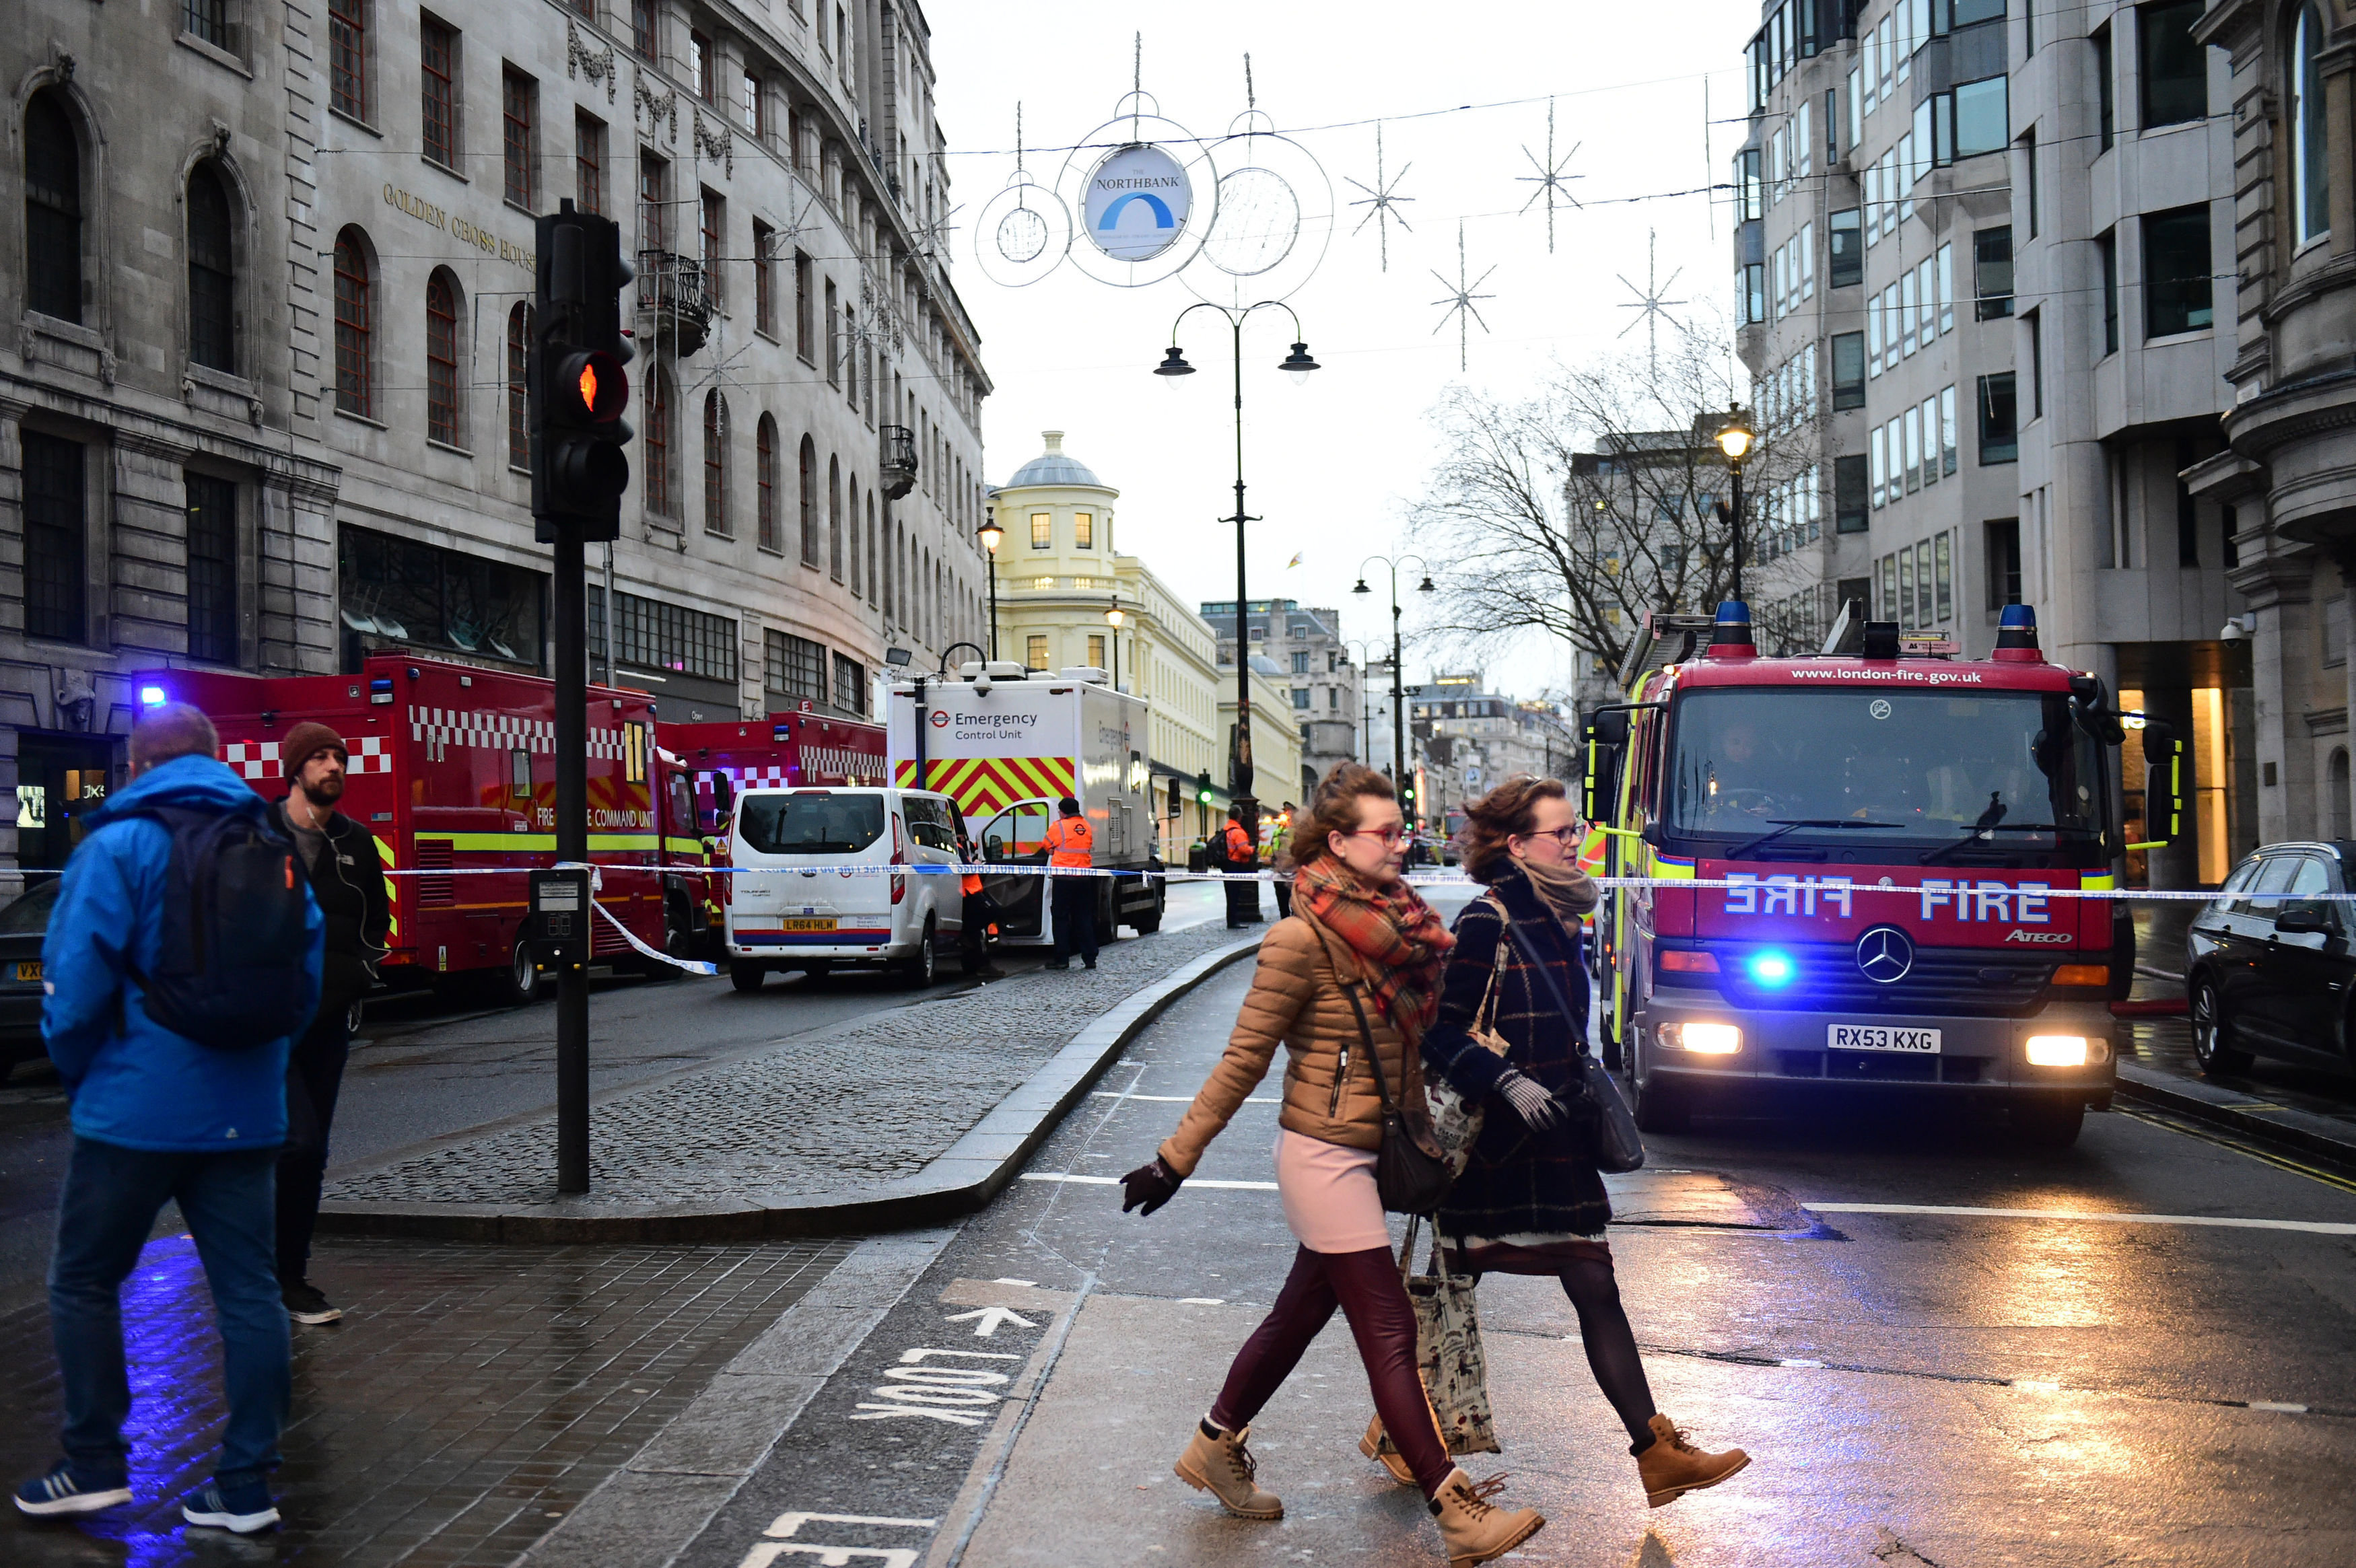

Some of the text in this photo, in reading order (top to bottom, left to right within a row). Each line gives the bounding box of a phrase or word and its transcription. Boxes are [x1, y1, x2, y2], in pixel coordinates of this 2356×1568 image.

[1097, 177, 1179, 190] NORTHBANK
[384, 183, 446, 230] GOLDEN
[452, 216, 495, 254] CROSS
[1791, 668, 1982, 684] www.london-fire.gov.uk
[802, 701, 810, 712] E
[691, 711, 703, 721] Open
[955, 713, 1037, 727] Emergency
[955, 730, 1022, 740] Control Unit
[537, 808, 555, 826] FIRE
[595, 809, 637, 827] COMMAND
[639, 810, 655, 828] UNIT
[1920, 879, 2050, 923] FIRE
[786, 920, 811, 929] LR64
[2005, 929, 2073, 943] ATEGO
[1836, 1028, 1932, 1050] RX53 KXG
[849, 1348, 1020, 1425] LOOK
